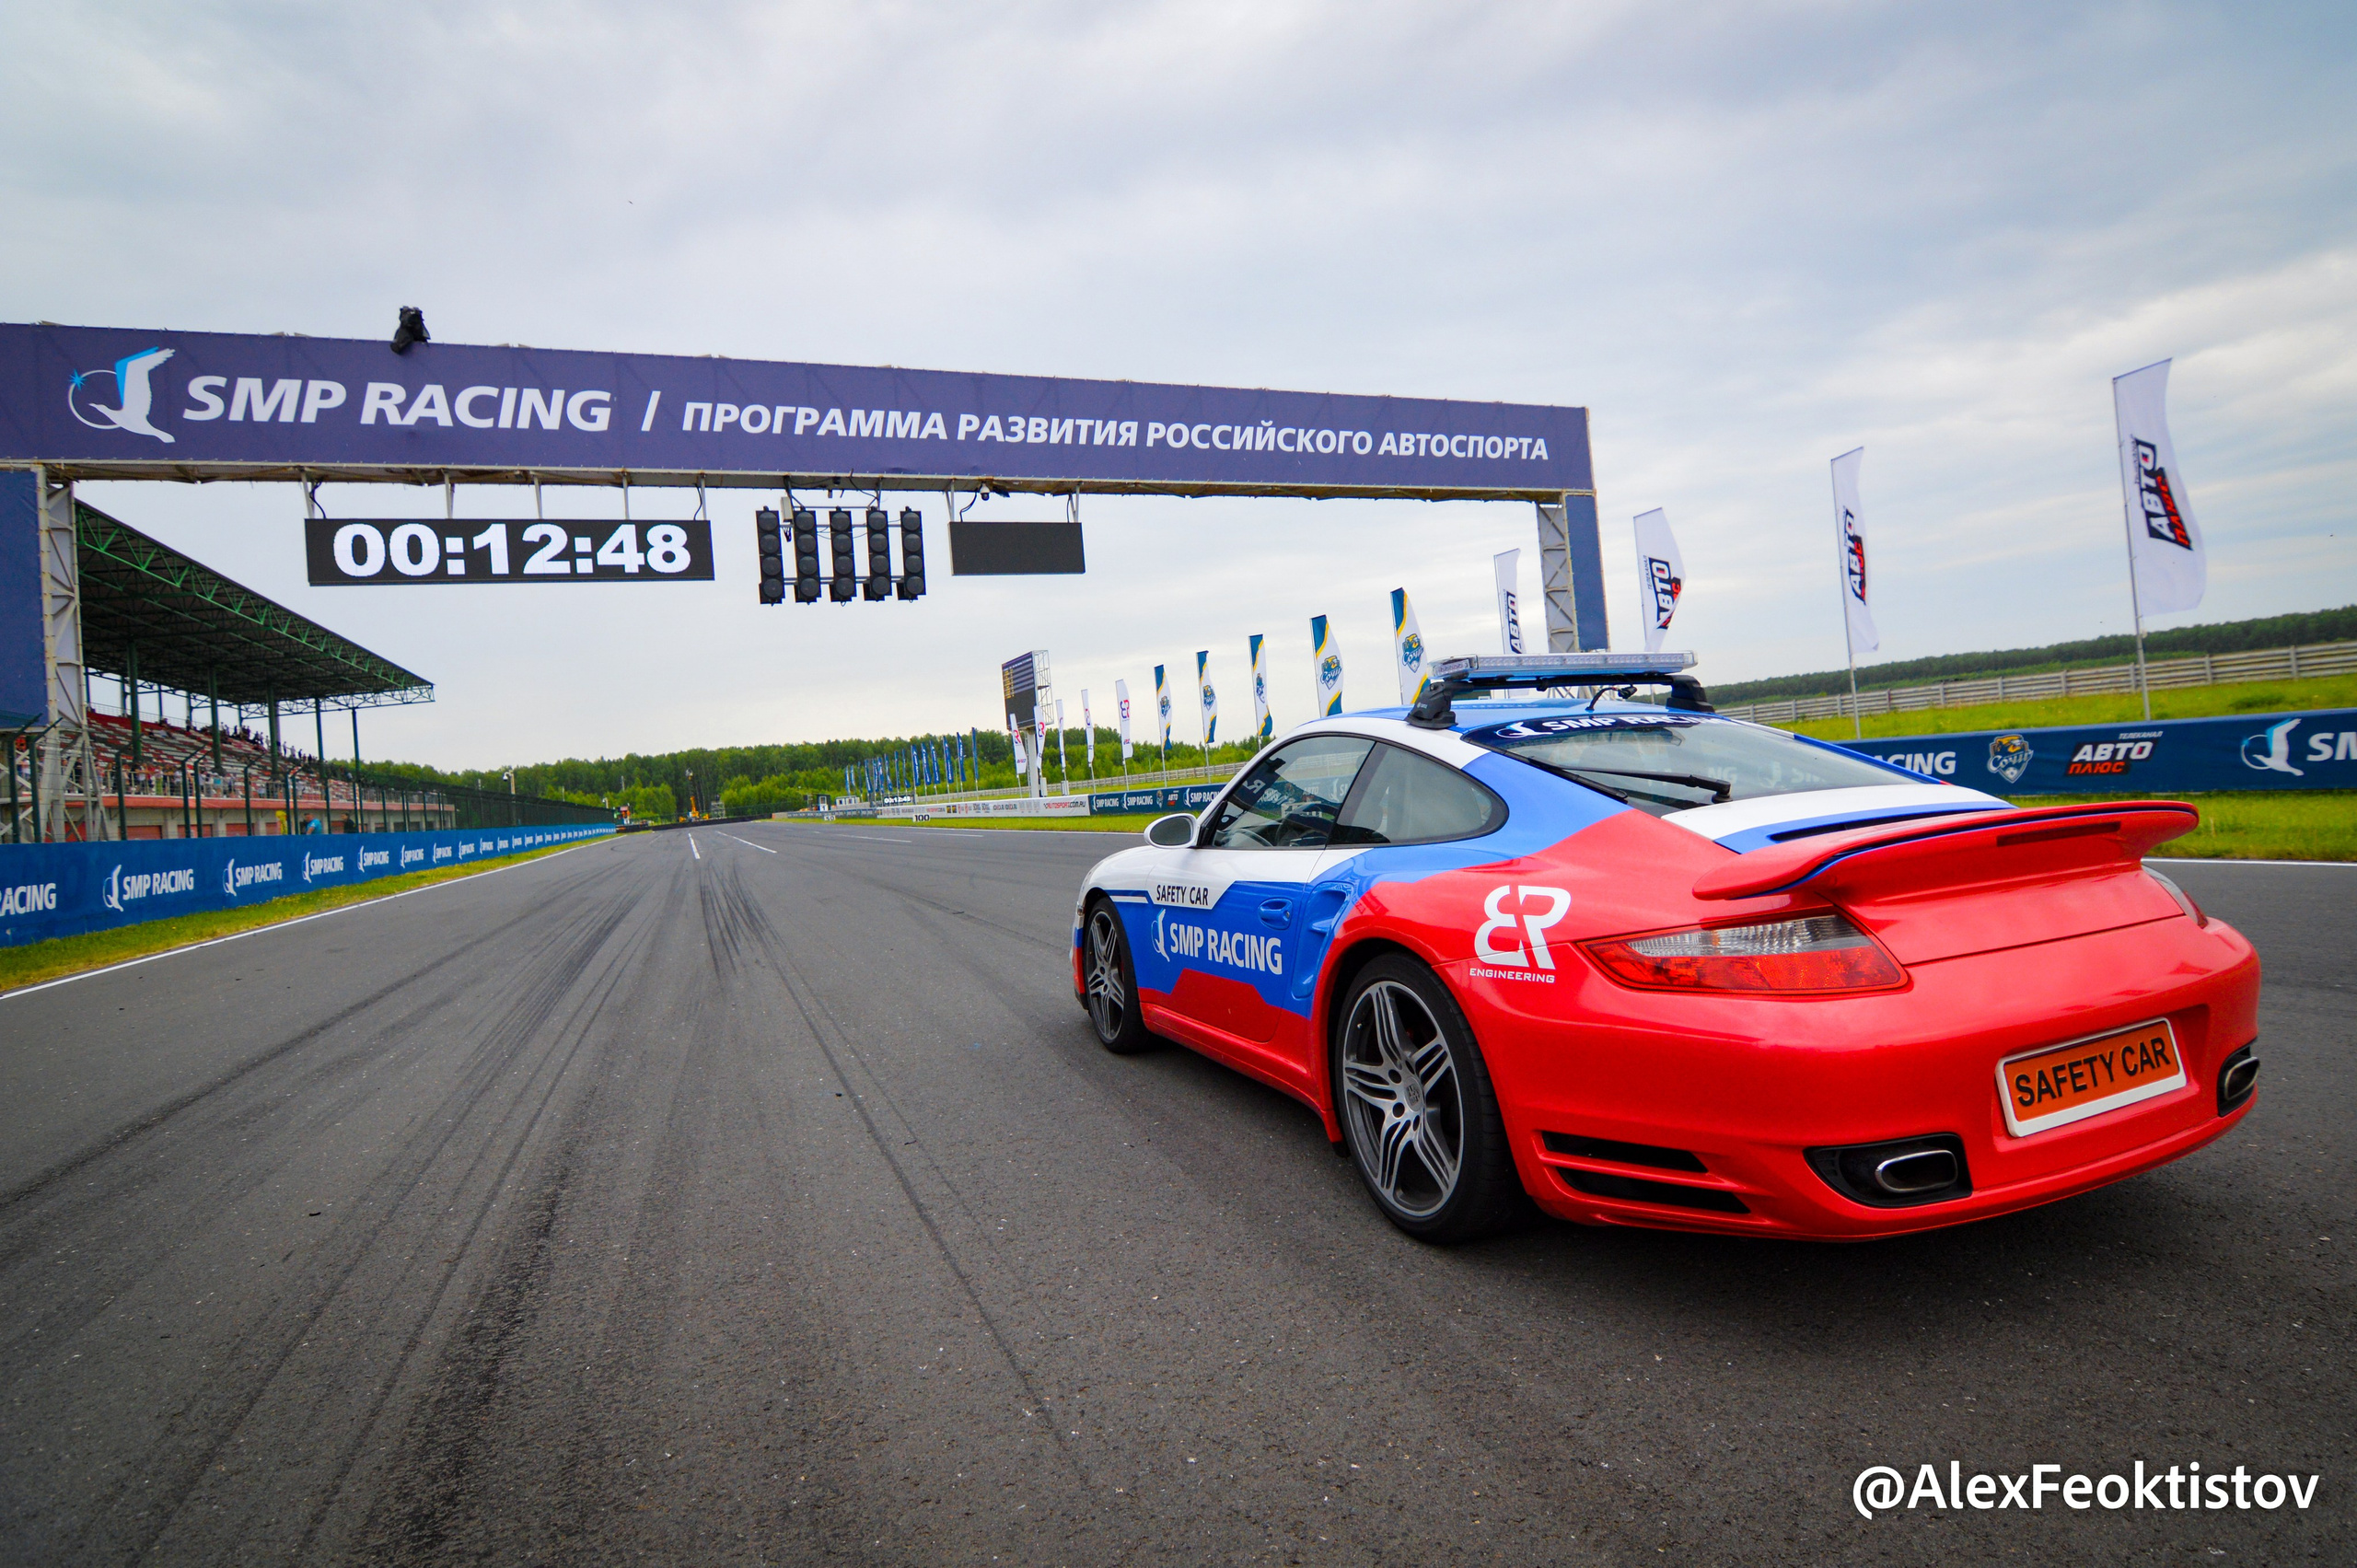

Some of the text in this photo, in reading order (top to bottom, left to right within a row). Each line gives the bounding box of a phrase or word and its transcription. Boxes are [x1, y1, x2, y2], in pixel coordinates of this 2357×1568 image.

[183, 376, 611, 432] SMP RACING
[682, 401, 1549, 460] ПРОГРАММА РАЗВИТИЯ РОССИЙСКОГО АВТОСПОРТА
[2137, 445, 2177, 541] АВТО
[332, 522, 691, 576] 00:12:48
[1542, 715, 1616, 731] SMP
[2119, 731, 2164, 740] ТЕЛЕКАНАЛ
[1987, 749, 2034, 774] Сочи
[2072, 741, 2154, 762] АВТО
[2068, 761, 2126, 775] ПЛЮС
[235, 861, 283, 888] SMP RACING
[323, 855, 343, 874] RACING
[122, 868, 194, 901] SMP RACING
[1156, 884, 1209, 906] SAFETY CAR
[1169, 923, 1283, 975] SMP RACING
[1469, 968, 1556, 984] ENGINEERING
[2014, 1037, 2171, 1108] SAFETY CAR
